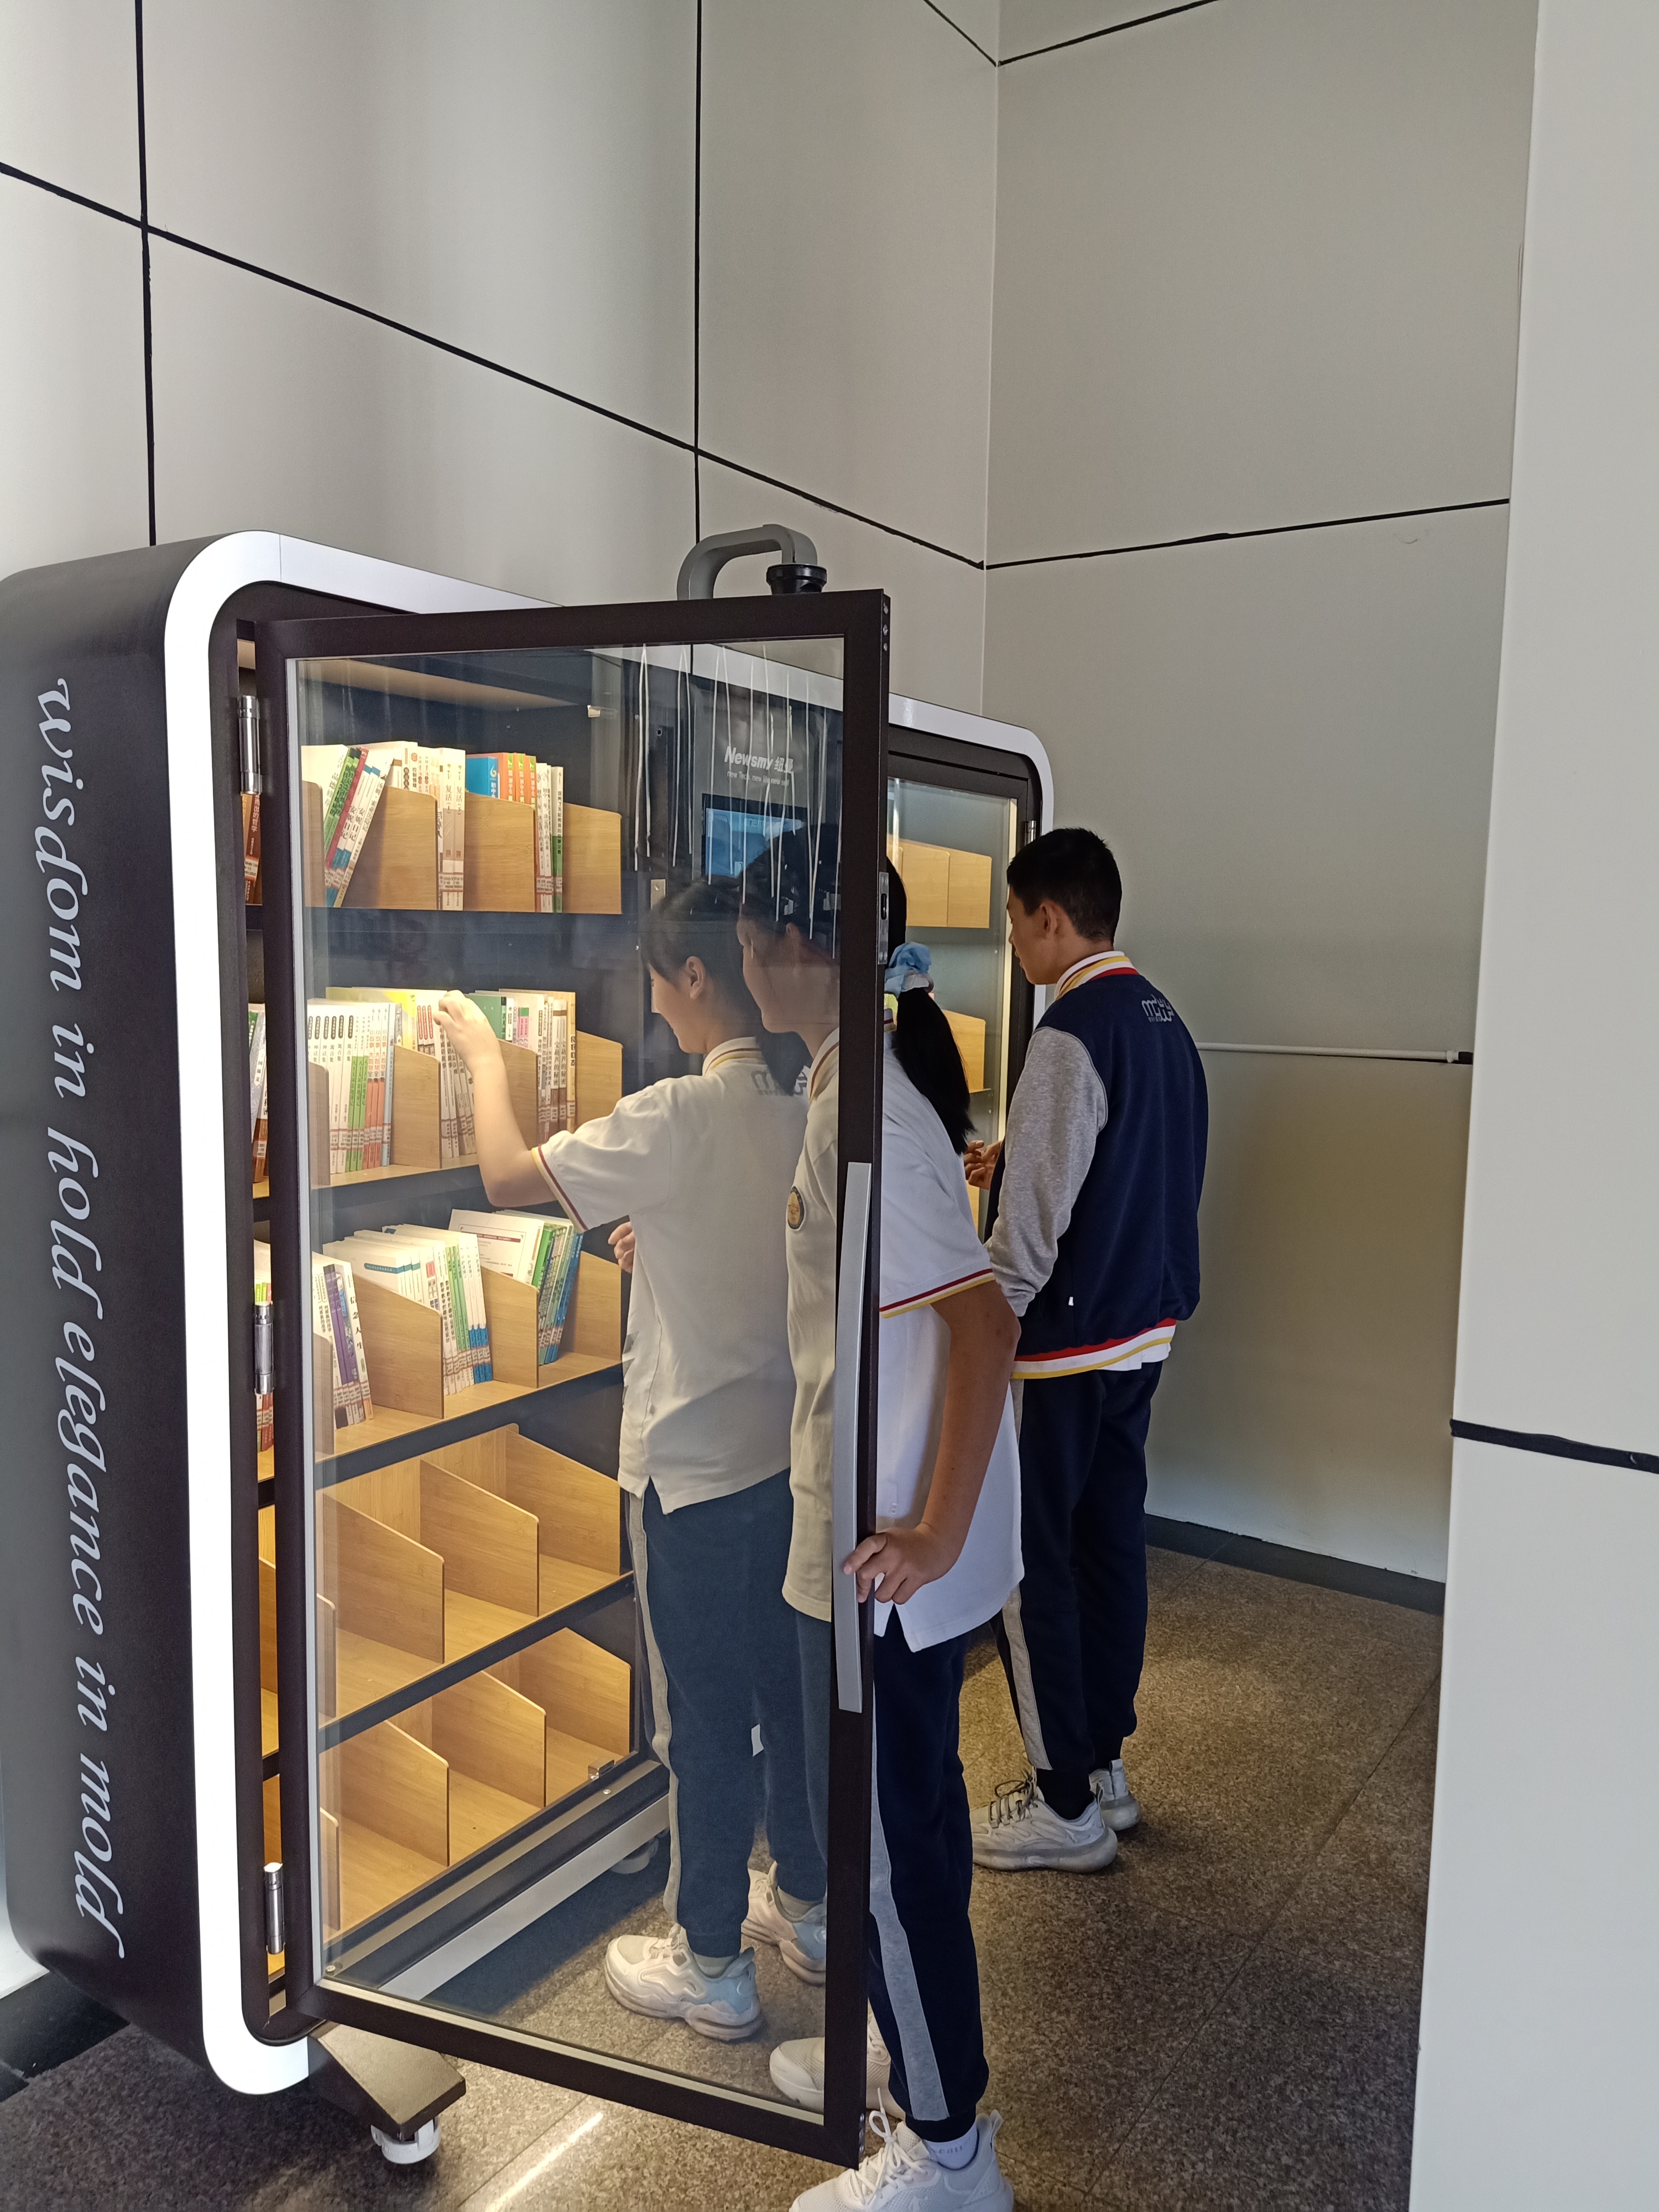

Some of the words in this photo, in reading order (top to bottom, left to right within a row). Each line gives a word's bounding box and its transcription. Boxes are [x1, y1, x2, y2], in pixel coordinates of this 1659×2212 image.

[724, 746, 774, 770] Newsmy
[34, 678, 88, 992] wisdom
[341, 805, 357, 839] 安妮日记
[348, 807, 366, 842] 安妮日记
[52, 1022, 95, 1098] in
[47, 1126, 103, 1320] hold
[55, 1322, 107, 1635] elegance
[75, 1656, 116, 1731] in
[74, 1752, 125, 1959] mold
